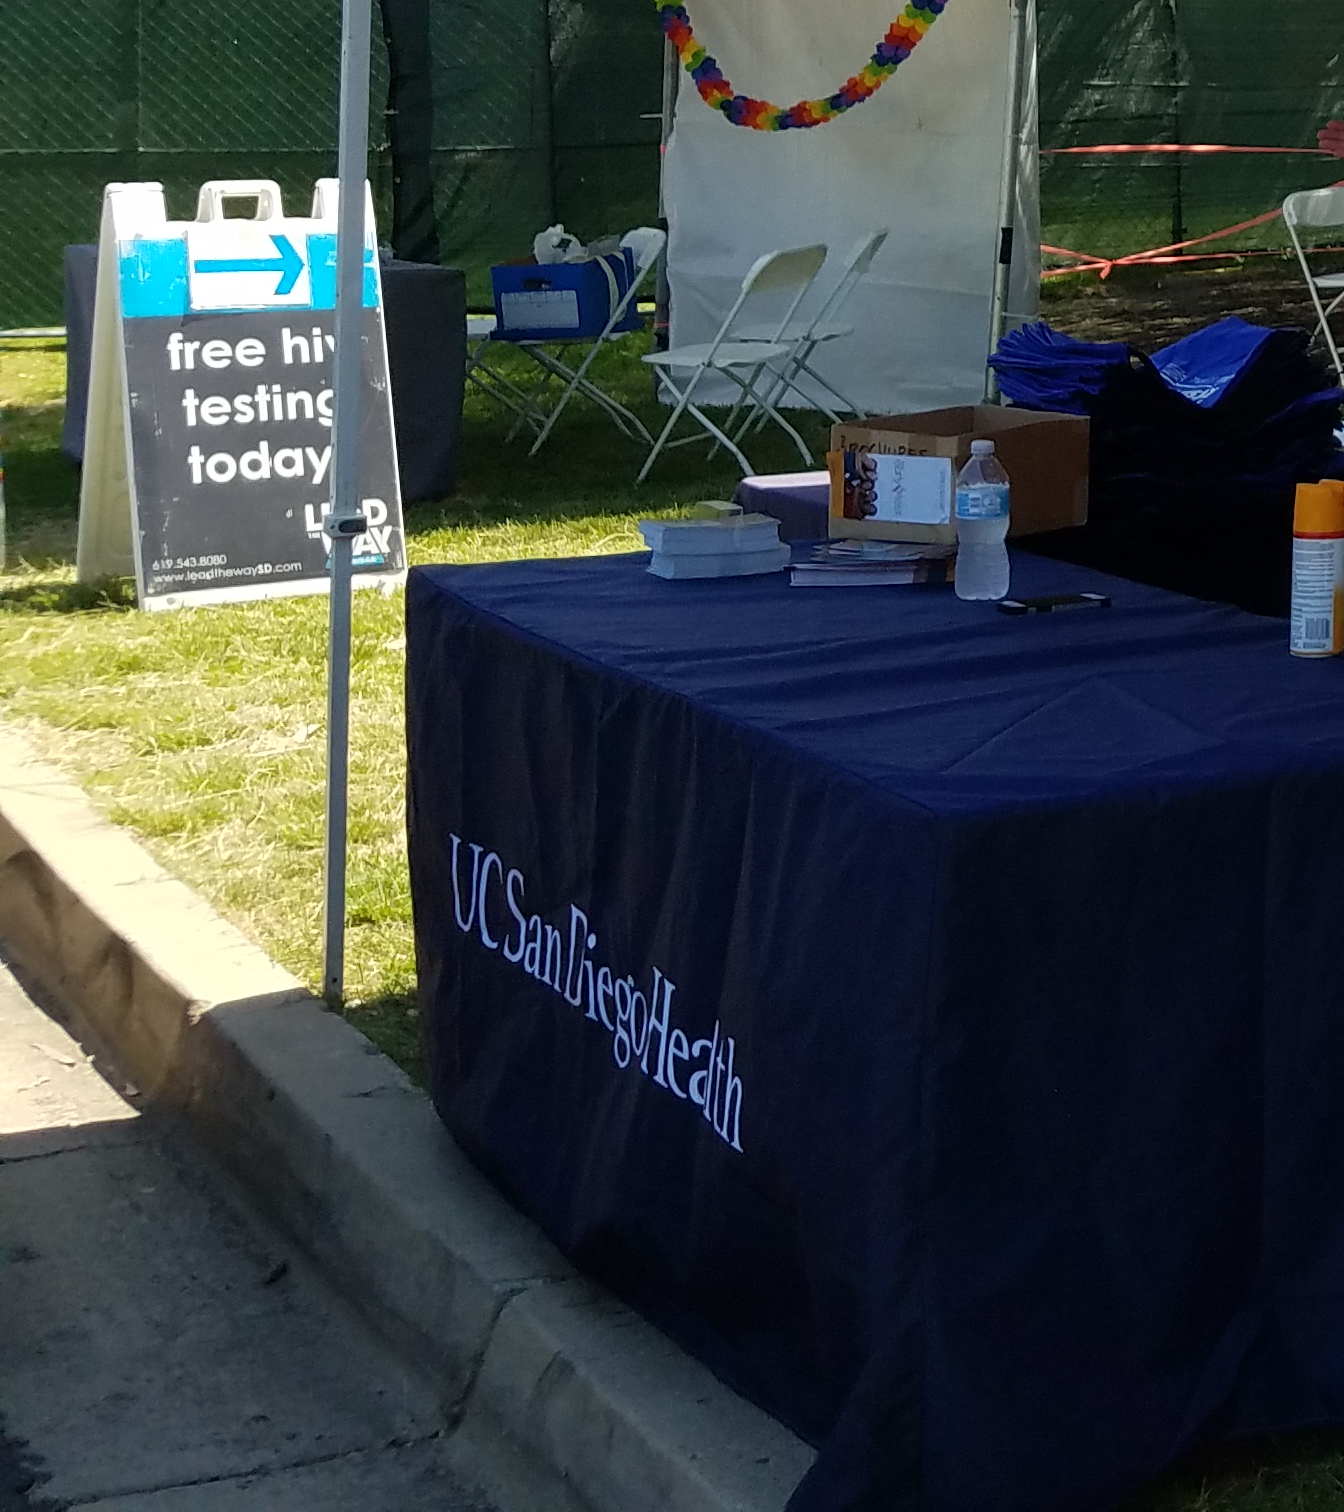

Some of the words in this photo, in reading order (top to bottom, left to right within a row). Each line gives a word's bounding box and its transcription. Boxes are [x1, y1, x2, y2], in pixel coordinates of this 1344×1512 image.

[166, 331, 266, 371] free
[182, 383, 333, 427] testing
[187, 440, 332, 485] today
[305, 498, 388, 532] LD
[449, 832, 504, 951] UC
[502, 868, 562, 994] San
[563, 902, 649, 1069] Diego
[640, 966, 744, 1154] Health
